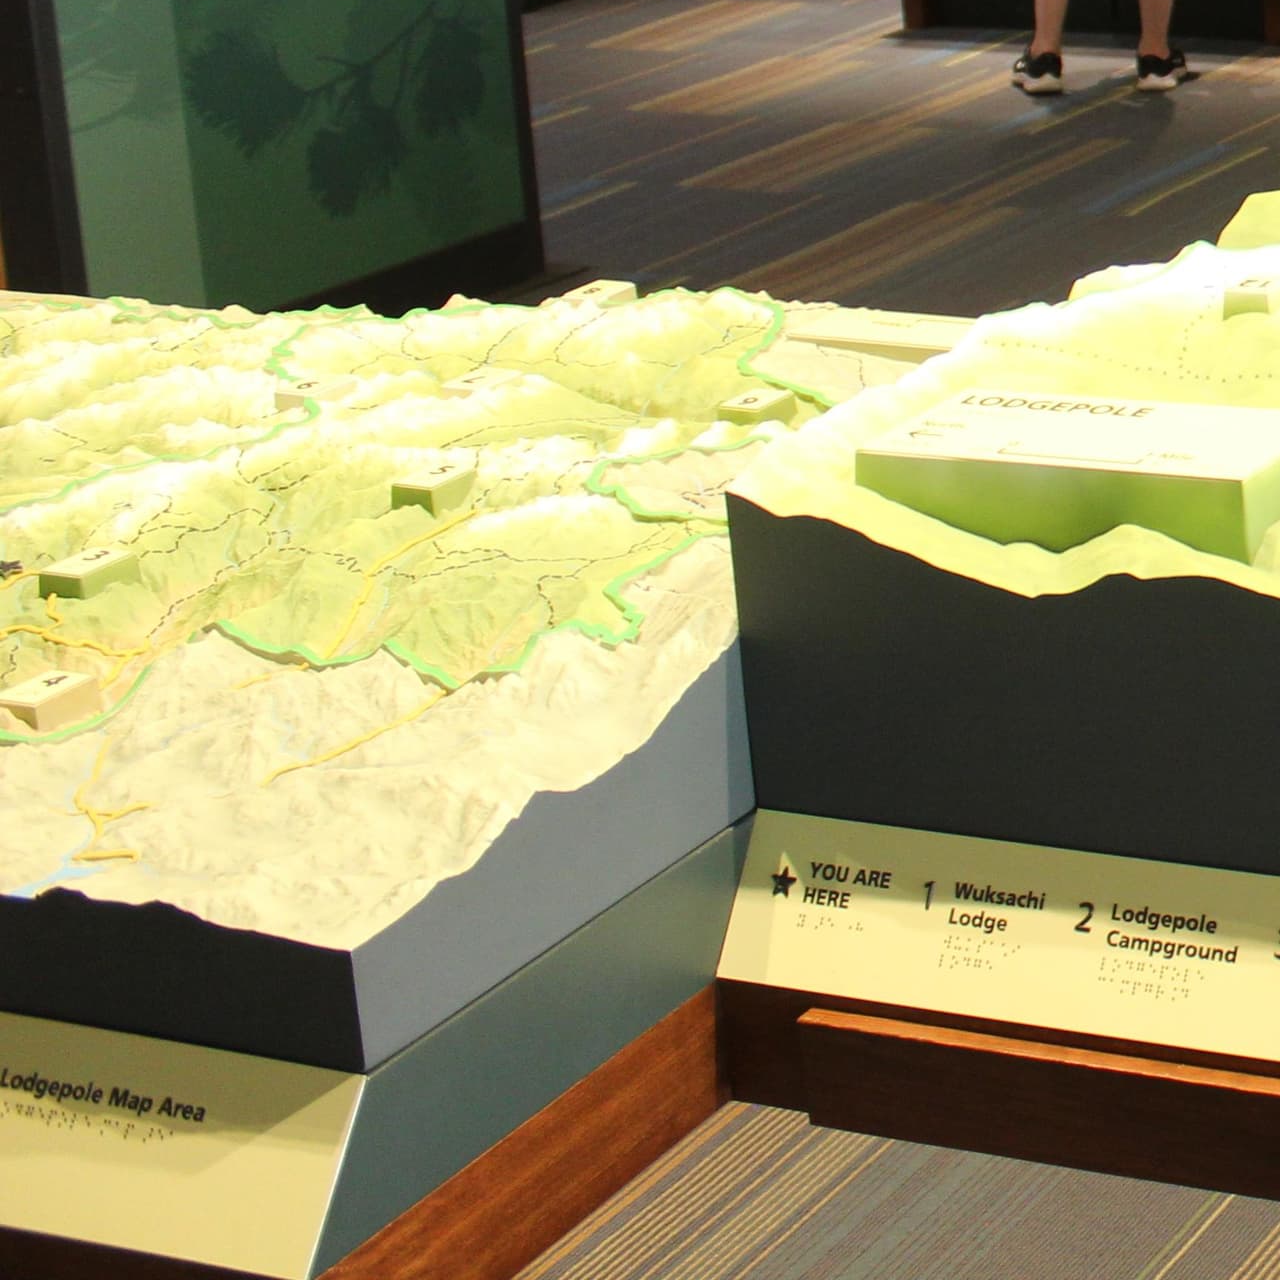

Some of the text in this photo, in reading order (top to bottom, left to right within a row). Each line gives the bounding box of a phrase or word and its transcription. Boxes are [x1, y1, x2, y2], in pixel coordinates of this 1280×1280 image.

[960, 394, 1154, 419] LODGEPOLE
[810, 862, 892, 889] YOU ARE
[802, 887, 851, 910] HERE
[923, 880, 1046, 911] 1 Wuksachi
[948, 908, 1008, 934] Lodge
[1074, 902, 1218, 934] 2 Lodgepole
[1106, 930, 1239, 964] Campground
[0, 1067, 206, 1123] Lodgepole Map Area
